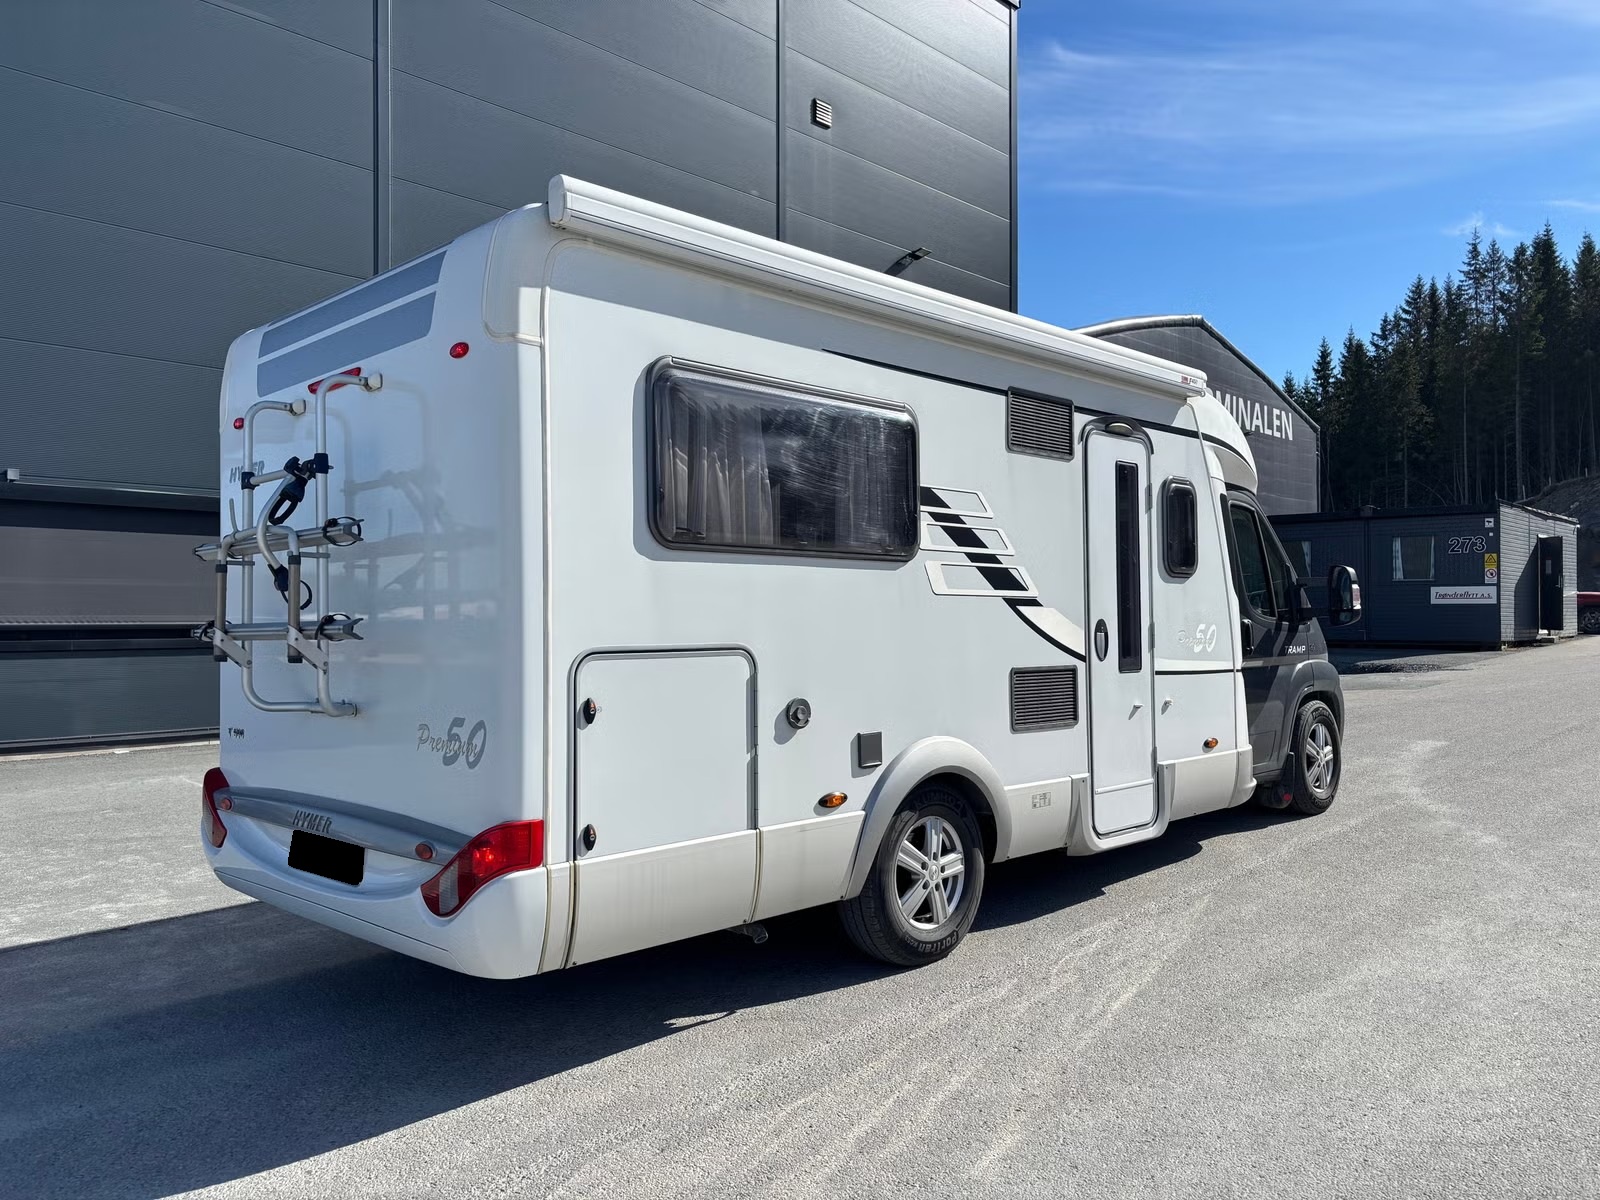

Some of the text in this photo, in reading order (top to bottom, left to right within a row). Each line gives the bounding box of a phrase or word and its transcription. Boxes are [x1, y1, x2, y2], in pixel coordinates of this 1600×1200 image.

[1448, 535, 1487, 554] 273
[1193, 623, 1217, 653] 50
[1284, 645, 1306, 654] TRAMP
[416, 716, 487, 770] Premium 50
[292, 809, 333, 834] HYMER
